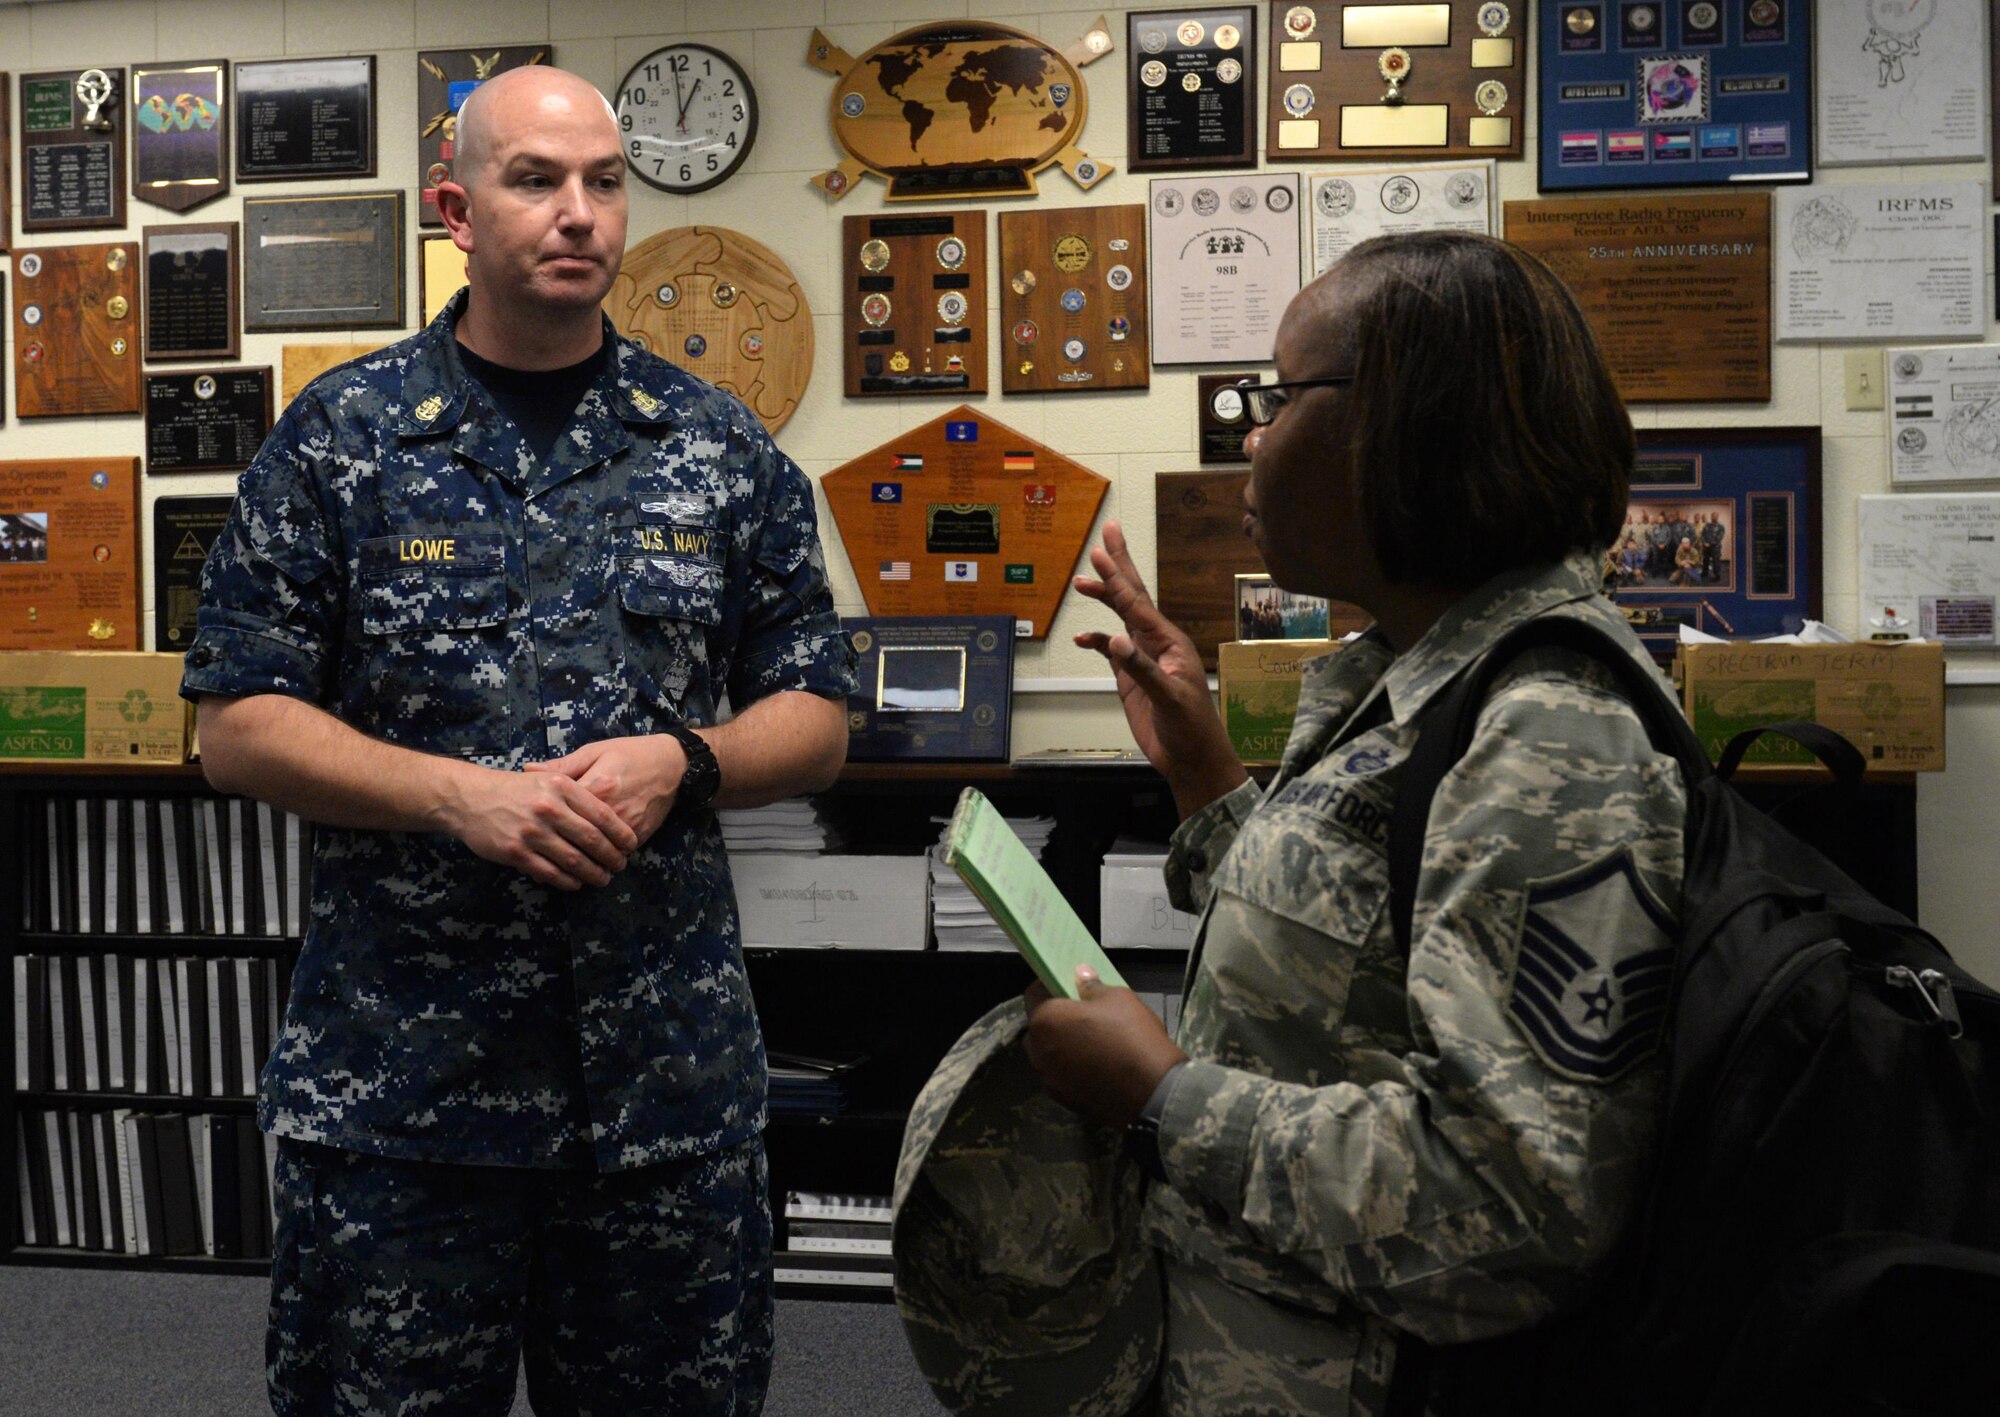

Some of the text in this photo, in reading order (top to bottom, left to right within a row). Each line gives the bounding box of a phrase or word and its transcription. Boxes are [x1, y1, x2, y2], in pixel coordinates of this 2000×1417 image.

[667, 54, 689, 72] 12
[703, 59, 711, 76] 1
[644, 64, 660, 81] 11
[723, 79, 734, 96] 2
[623, 88, 645, 106] 10
[651, 99, 660, 107] 22
[703, 95, 712, 103] 14
[648, 116, 657, 124] 21
[708, 111, 717, 119] 15
[733, 104, 744, 122] 3
[621, 114, 633, 132] 9
[726, 132, 737, 149] 4
[631, 141, 642, 158] 8
[653, 159, 666, 176] 7
[707, 154, 718, 171] 5
[680, 164, 691, 181] 6
[1878, 198, 1953, 212] IRFMS
[1527, 206, 1747, 224] Interservice Radio Frequency
[1574, 226, 1627, 237] Keesler
[1674, 224, 1700, 235] MS
[1588, 242, 1756, 259] 25TH ANNIVERSARY
[1216, 265, 1238, 276] 98B
[399, 538, 456, 562] LOWE
[640, 530, 711, 556] U.S. NAVY
[1813, 650, 1894, 673] TERM
[3, 735, 73, 751] ASPEN 50
[1241, 735, 1289, 752] ASPE
[1775, 737, 1799, 753] 50
